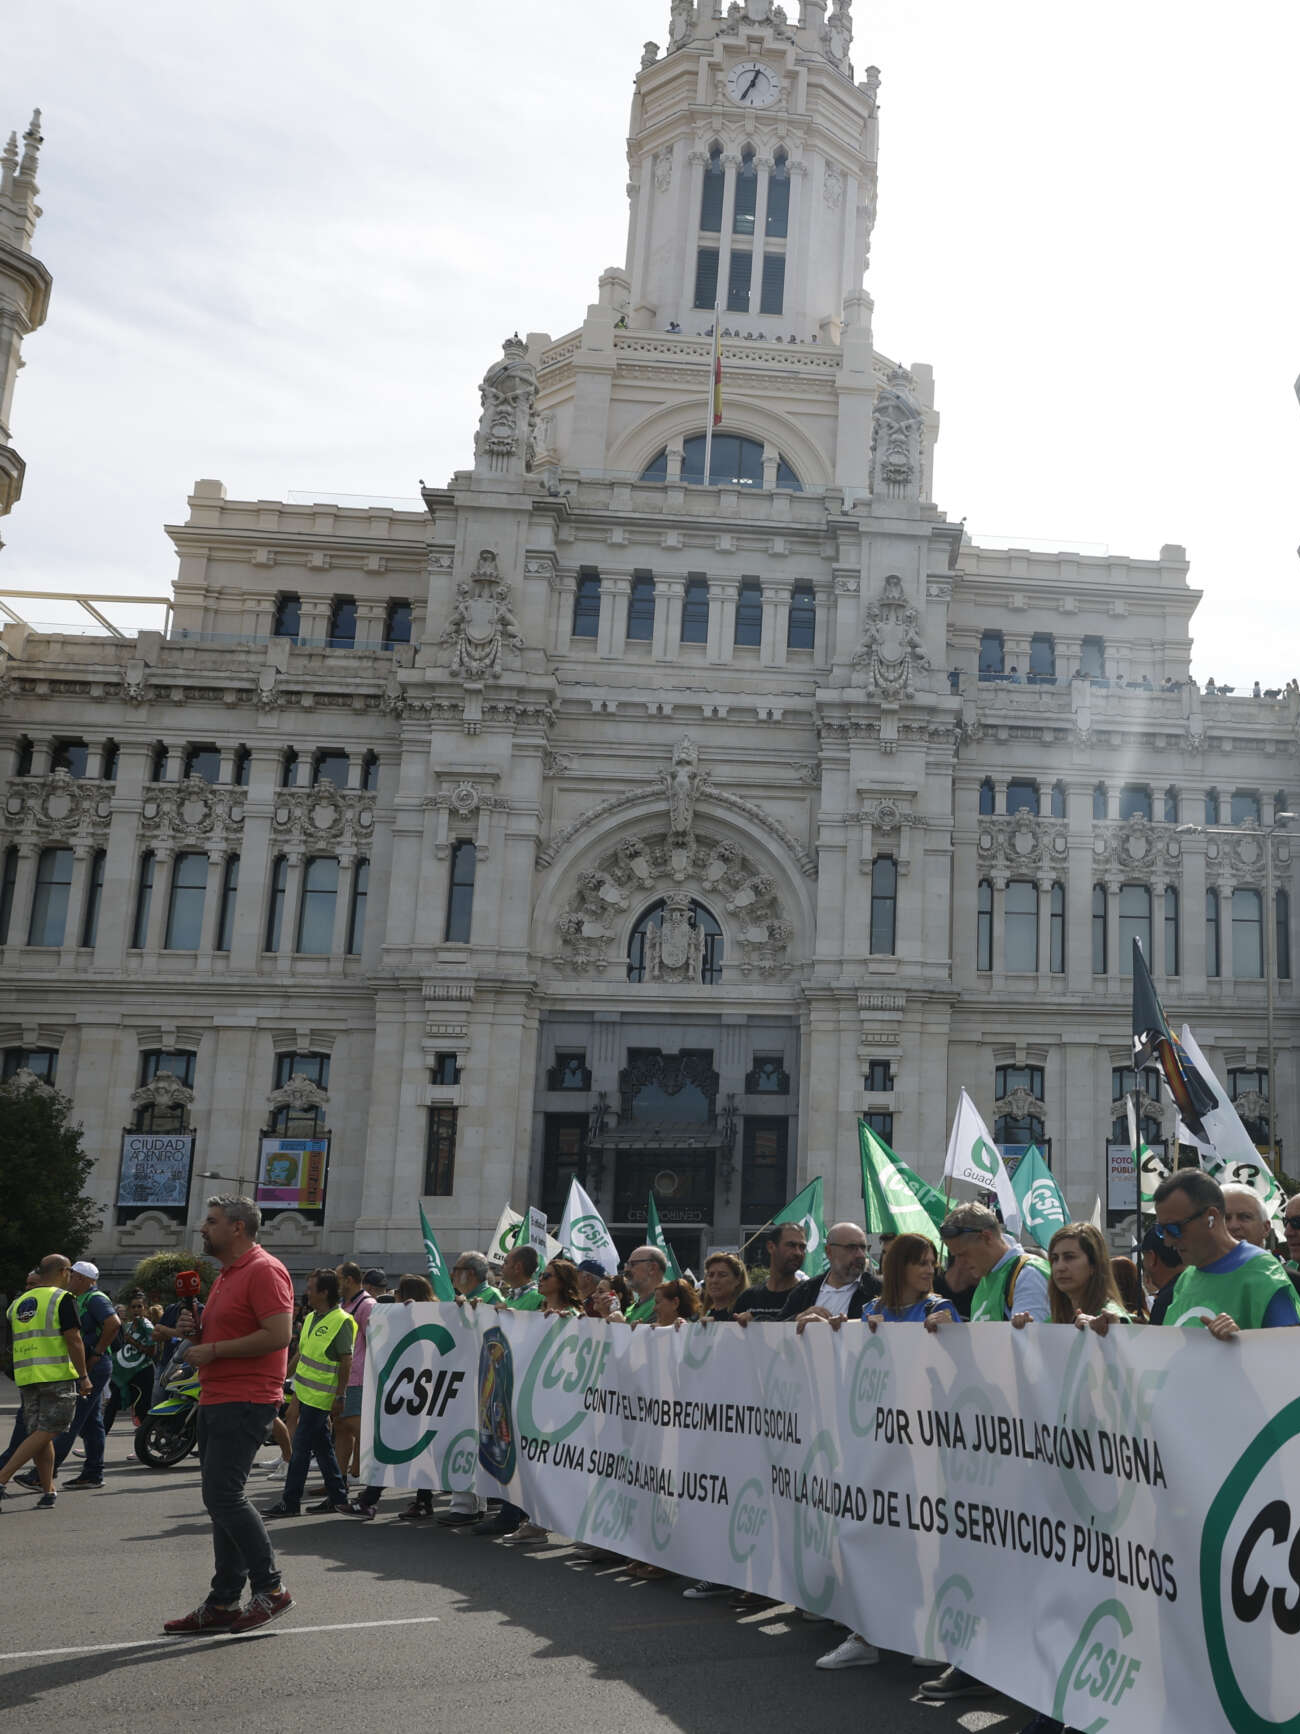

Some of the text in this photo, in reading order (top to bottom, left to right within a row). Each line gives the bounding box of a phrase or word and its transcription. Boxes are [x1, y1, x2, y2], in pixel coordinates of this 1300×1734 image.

[130, 1139, 185, 1151] CIUDAD
[577, 1222, 609, 1250] CSIF
[542, 1334, 613, 1394] CSIF
[857, 1368, 889, 1403] CSIF
[384, 1367, 465, 1417] CSIF
[621, 1395, 637, 1421] EL
[763, 1408, 801, 1444] SOCIAL
[452, 1452, 477, 1474] CSI
[520, 1436, 550, 1464] POR
[553, 1442, 585, 1472] UNA
[627, 1460, 675, 1498] SALARIAL
[678, 1471, 729, 1506] JUSTA
[875, 1406, 1168, 1489] POR UNA JUBILACIÓN DIGNA
[735, 1502, 768, 1537] CSIF
[771, 1464, 1178, 1602] POR LA CALIDAD DE LOS SERVICIOS PÚBLICOS
[939, 1606, 981, 1651] CSIF
[1073, 1641, 1142, 1706] CSIF
